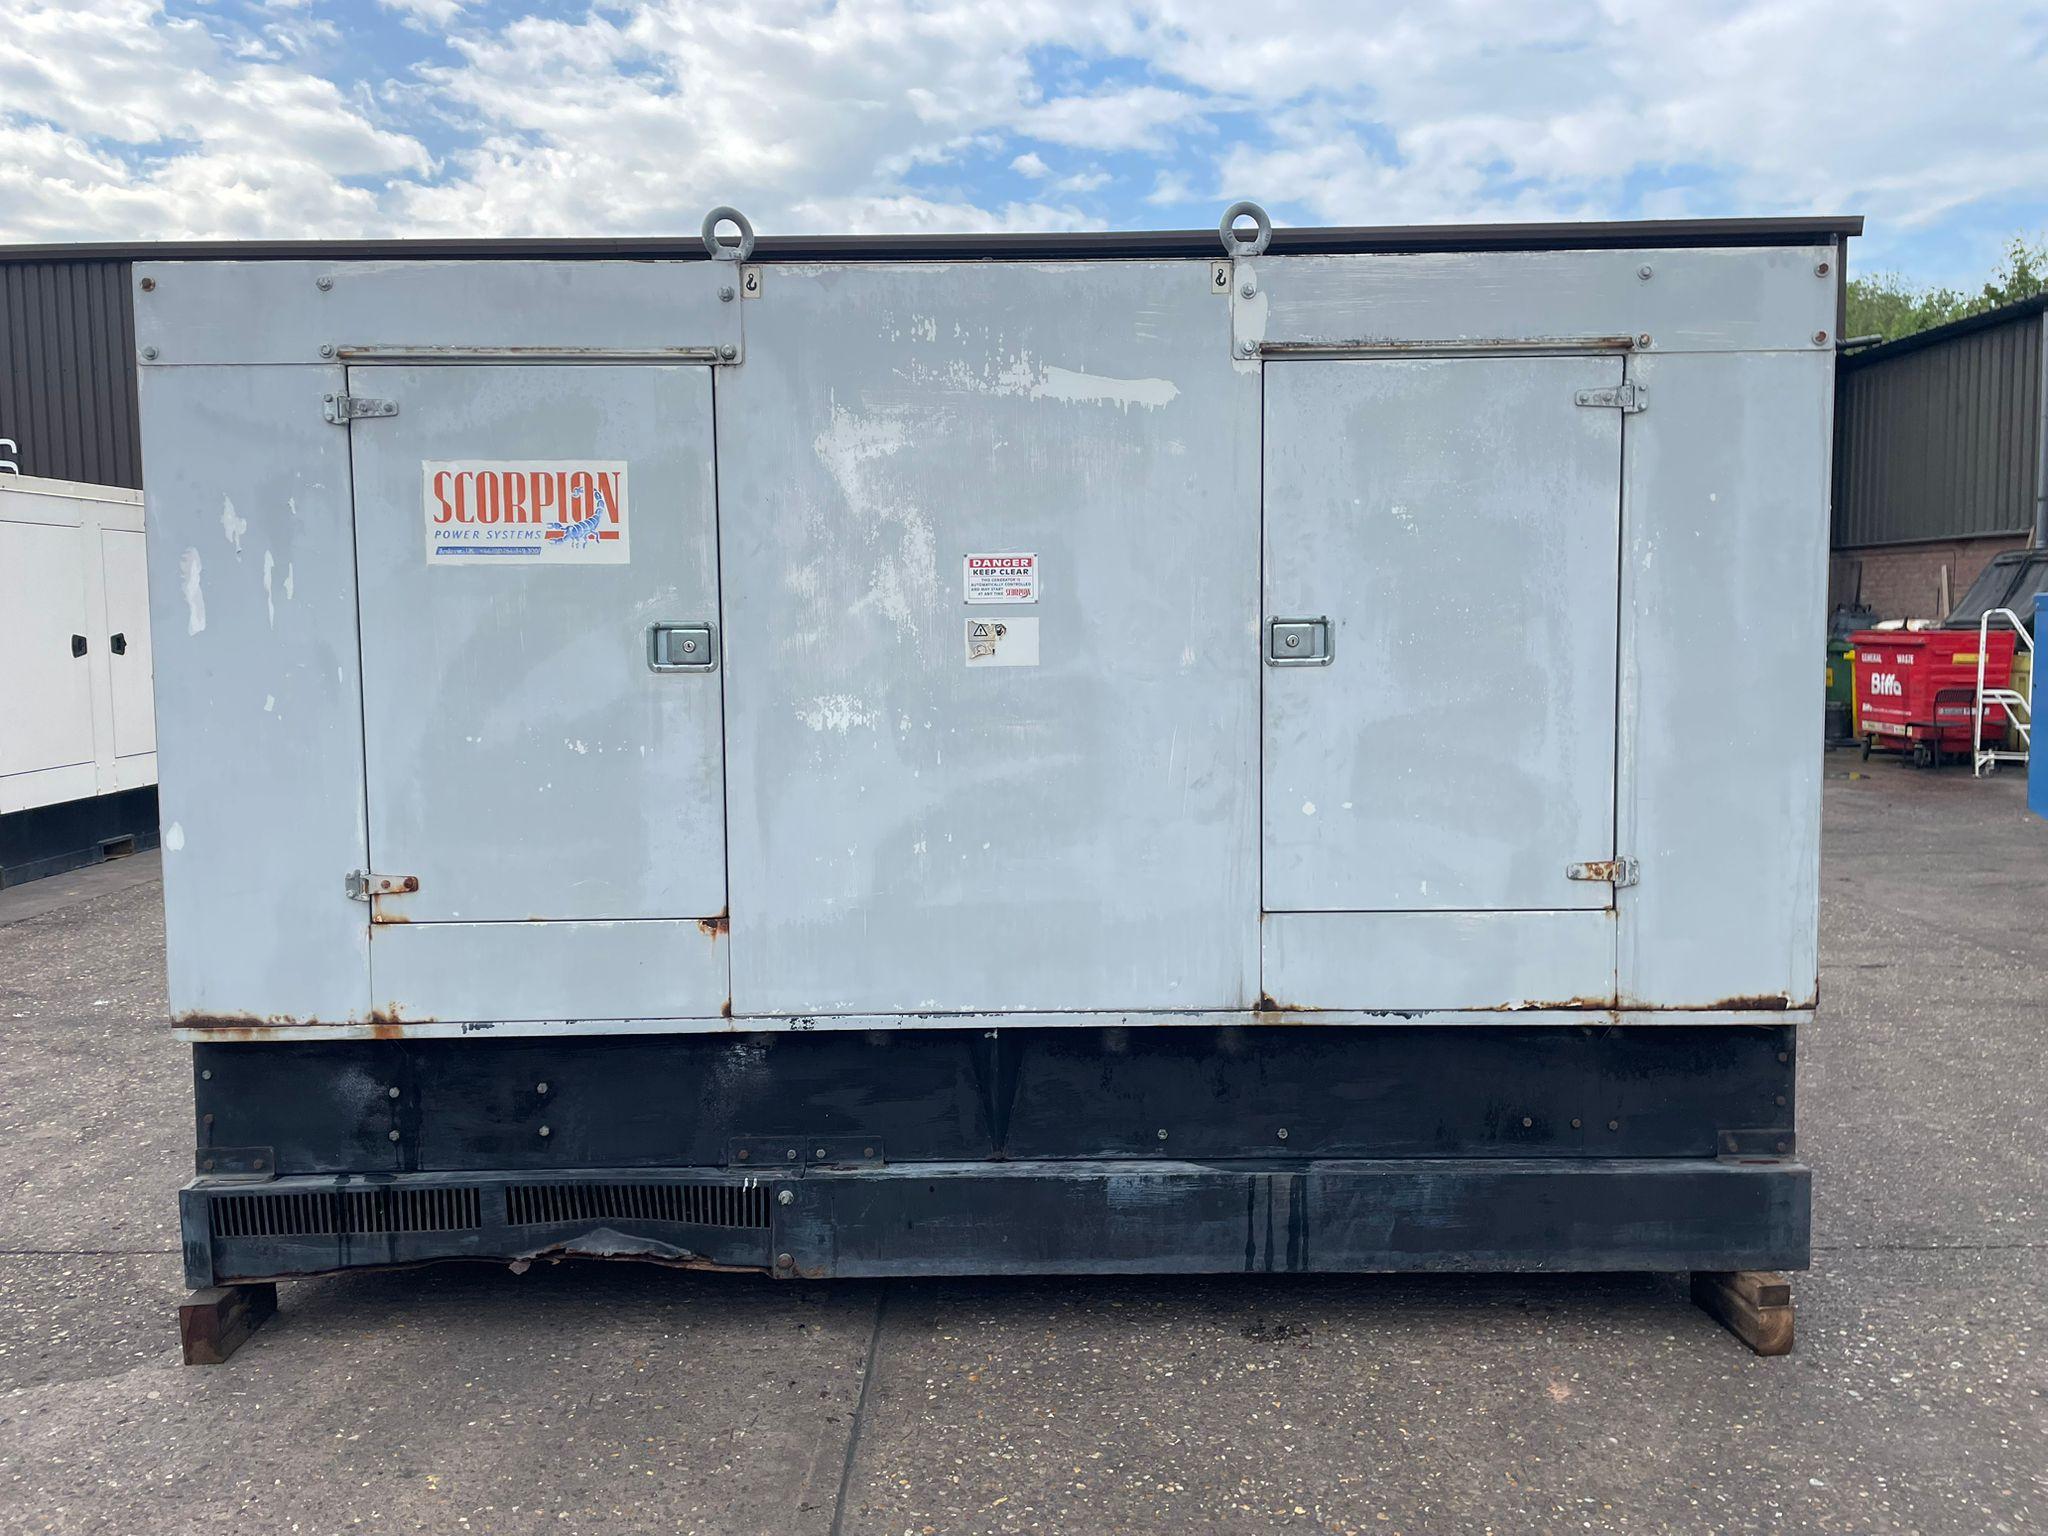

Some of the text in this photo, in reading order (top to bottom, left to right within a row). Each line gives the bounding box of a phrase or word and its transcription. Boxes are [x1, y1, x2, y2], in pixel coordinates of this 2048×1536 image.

[433, 470, 621, 524] SCORPION
[434, 530, 542, 540] POWER SYSTEMS
[972, 559, 1029, 567] DANGER
[972, 568, 997, 576] KEEP
[1896, 654, 1914, 665] WASTE
[1871, 672, 1902, 696] Biffa
